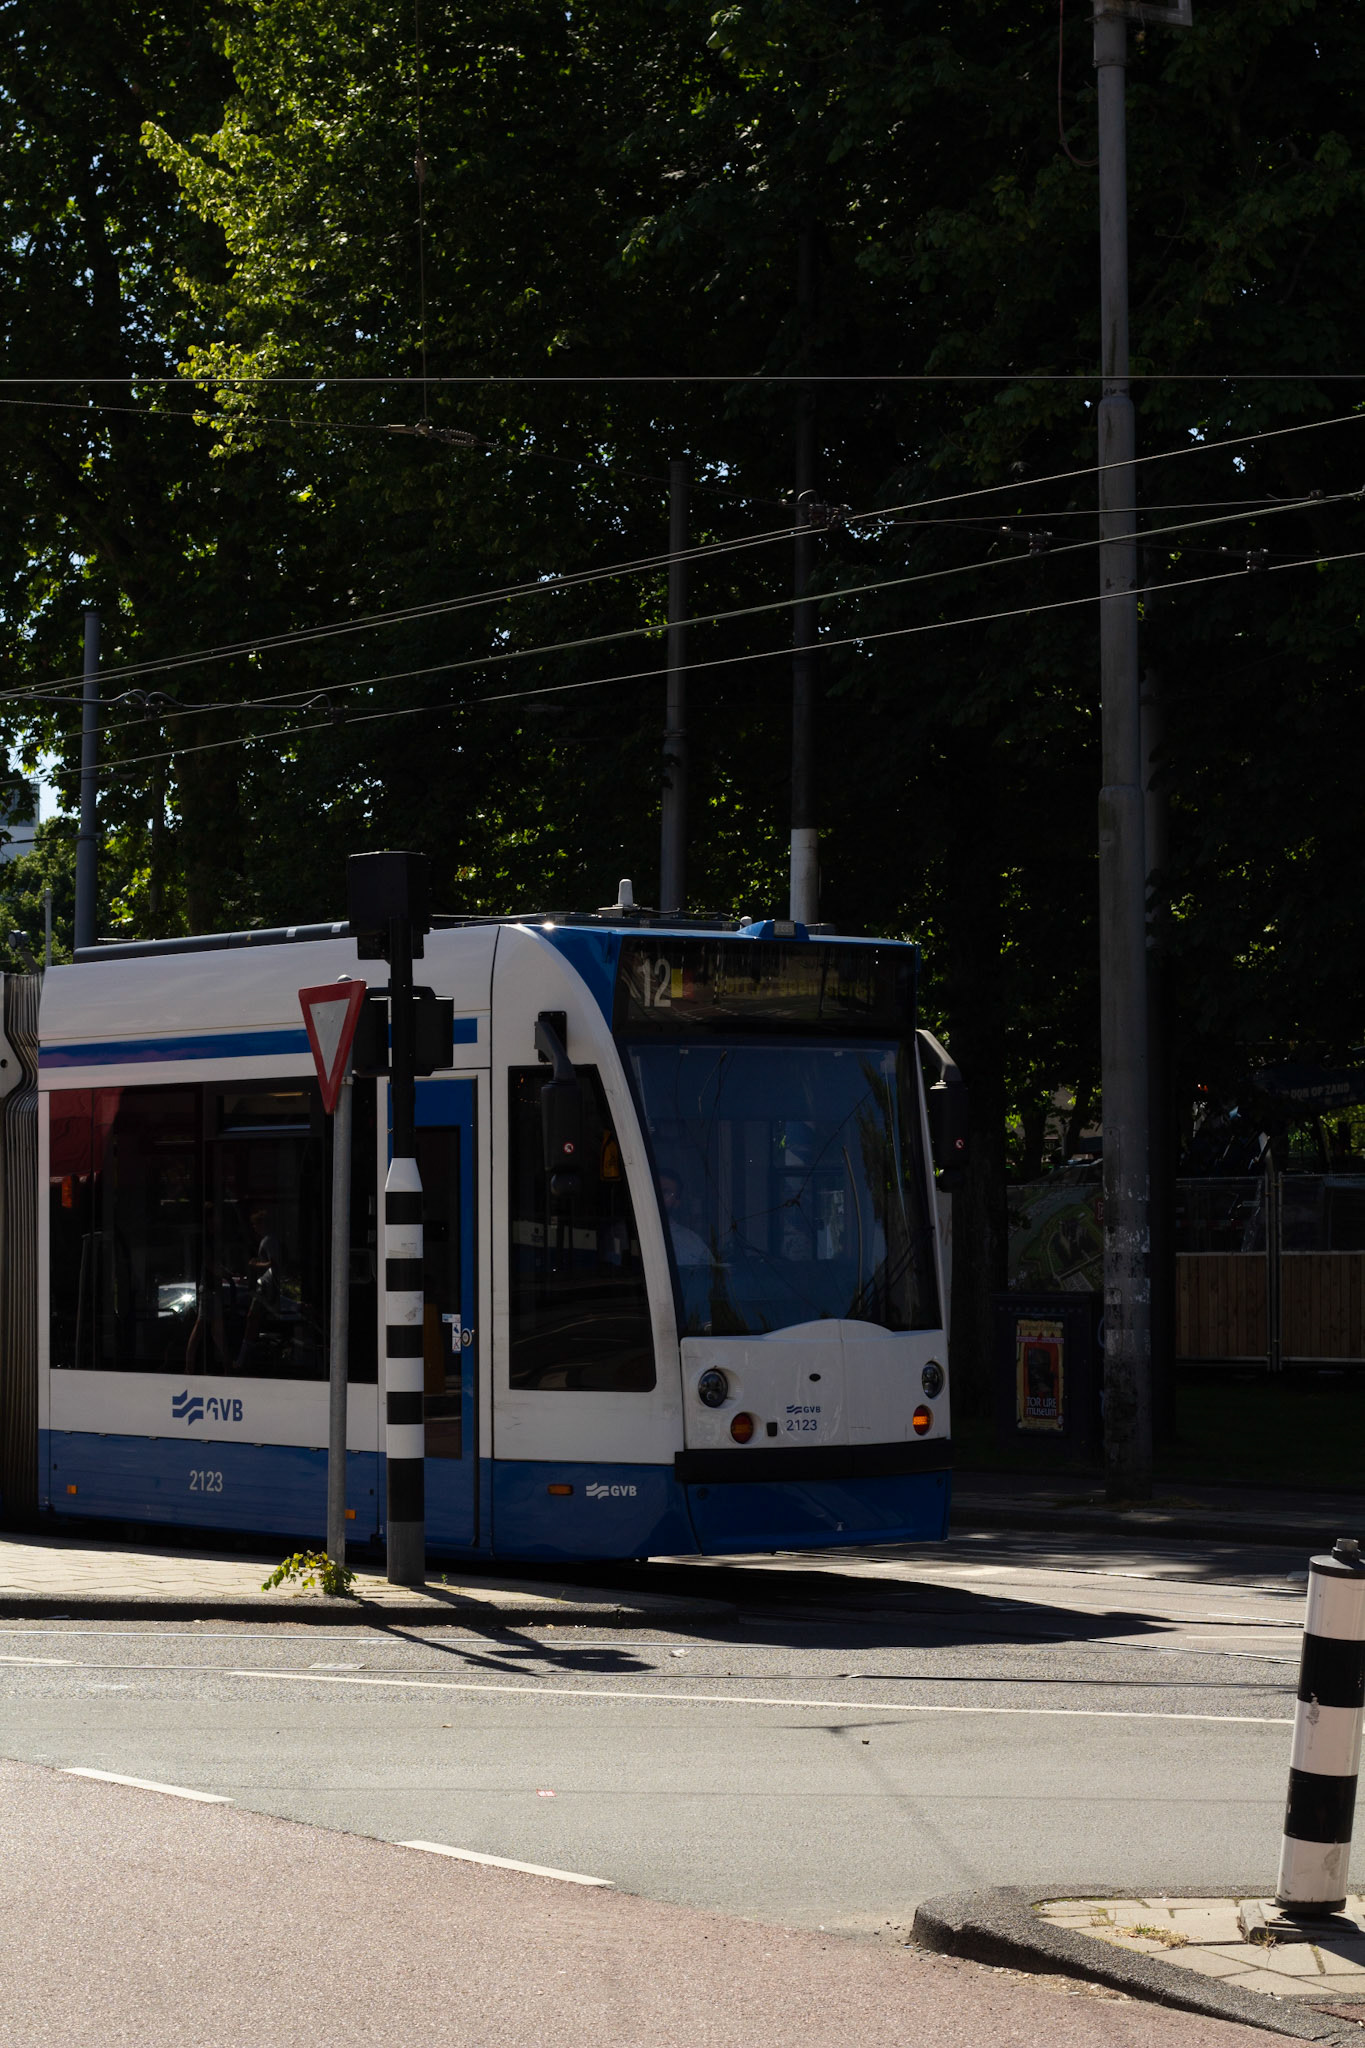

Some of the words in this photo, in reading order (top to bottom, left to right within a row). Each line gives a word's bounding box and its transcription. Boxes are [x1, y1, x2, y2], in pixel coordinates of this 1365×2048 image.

[642, 957, 672, 1008] 12
[206, 1397, 244, 1422] GVB
[1026, 1397, 1057, 1408] TORURE
[803, 1406, 822, 1414] GVB
[785, 1418, 818, 1432] 2123
[189, 1469, 224, 1493] 2123
[610, 1484, 638, 1497] GVB
